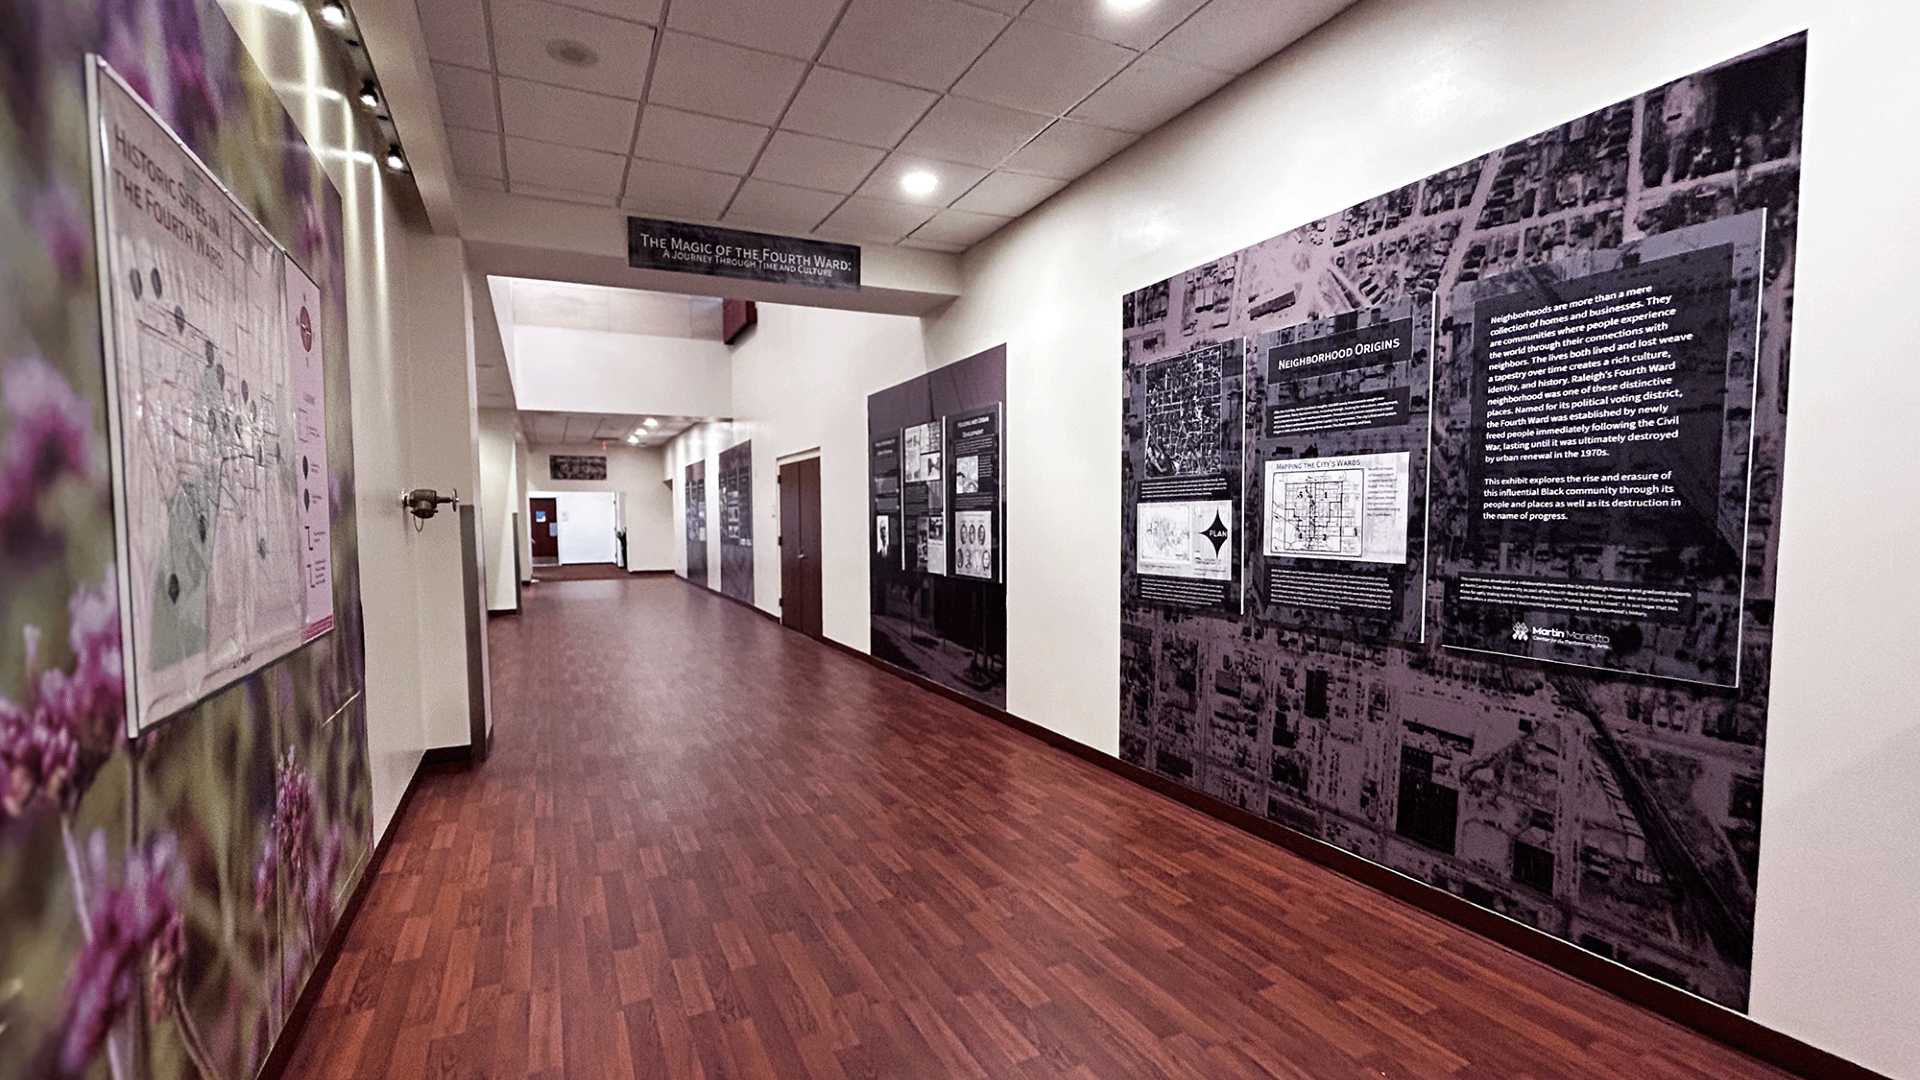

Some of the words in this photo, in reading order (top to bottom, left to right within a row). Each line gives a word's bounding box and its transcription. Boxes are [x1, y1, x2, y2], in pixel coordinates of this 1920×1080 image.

[115, 124, 175, 199] HISTORIC
[178, 182, 207, 226] SITES
[113, 169, 143, 209] THE
[146, 186, 192, 248] FOURTH
[640, 233, 666, 249] THE
[671, 238, 711, 254] MAGIC
[716, 245, 732, 256] OF
[736, 247, 758, 260] THE
[763, 249, 810, 266] FOURTH
[814, 255, 851, 271] WARD:
[663, 250, 670, 258] A
[672, 251, 712, 264] JOURNEY
[715, 255, 756, 268] THROUGH
[759, 260, 777, 270] TIME
[779, 264, 796, 272] AND
[797, 265, 832, 277] CULTURE
[1490, 324, 1528, 335] collection
[1530, 319, 1538, 328] of
[1540, 316, 1568, 326] homes
[1570, 311, 1587, 320] and
[1590, 302, 1646, 316] businesses.
[1647, 296, 1672, 305] They
[1491, 307, 1552, 323] Neighborhoods
[1569, 298, 1593, 307] more
[1595, 293, 1616, 302] than
[1626, 286, 1652, 296] mere
[1503, 331, 1556, 344] communities
[1558, 325, 1585, 335] where
[1587, 318, 1619, 331] people
[1620, 309, 1676, 323] experience
[1503, 346, 1526, 356] world
[1527, 341, 1560, 352] through
[1562, 337, 1584, 346] their
[1585, 328, 1643, 342] connections
[1645, 322, 1668, 332] with
[1278, 348, 1352, 370] NEIGHBORHOOD
[1355, 338, 1400, 356] ORIGINS
[1489, 360, 1529, 370] neighbors.
[1570, 348, 1591, 358] both
[1593, 344, 1615, 354] lived
[1617, 341, 1636, 350] and
[1639, 338, 1656, 347] lost
[1659, 334, 1693, 343] weave
[1495, 372, 1526, 381] tapestry
[1569, 361, 1601, 370] creates
[1612, 356, 1629, 364] rich
[1632, 351, 1671, 361] culture,
[1488, 385, 1519, 393] identity,
[1521, 381, 1536, 389] and
[1572, 371, 1613, 382] Raleigh's
[1614, 366, 1646, 376] Fourth
[1649, 362, 1675, 372] Ward
[1488, 392, 1543, 405] neighborhood
[1620, 378, 1672, 389] distinctive
[1487, 409, 1513, 418] places.
[1515, 404, 1544, 413] Named
[1571, 397, 1608, 409] political
[1610, 395, 1641, 403] voting
[1643, 390, 1682, 400] district,
[1501, 418, 1526, 426] Fourth
[1528, 416, 1549, 424] Ward
[1569, 409, 1621, 420] established
[1624, 408, 1636, 416] by
[1638, 405, 1668, 413] newly
[1503, 442, 1529, 450] lasting
[1531, 440, 1550, 448] until
[1578, 435, 1626, 444] ultimately
[1628, 430, 1678, 440] destroyed
[1507, 430, 1534, 439] people
[1536, 425, 1590, 435] immediately
[1592, 422, 1636, 430] following
[1638, 419, 1654, 427] the
[1656, 417, 1679, 425] Civil
[1316, 460, 1336, 468] CITY'S
[1520, 452, 1552, 460] renewal
[1581, 449, 1609, 457] 1970s.
[1566, 487, 1617, 495] community
[1620, 486, 1659, 495] through
[1601, 473, 1619, 481] and
[1661, 471, 1672, 479] of
[1532, 626, 1564, 638] Martin
